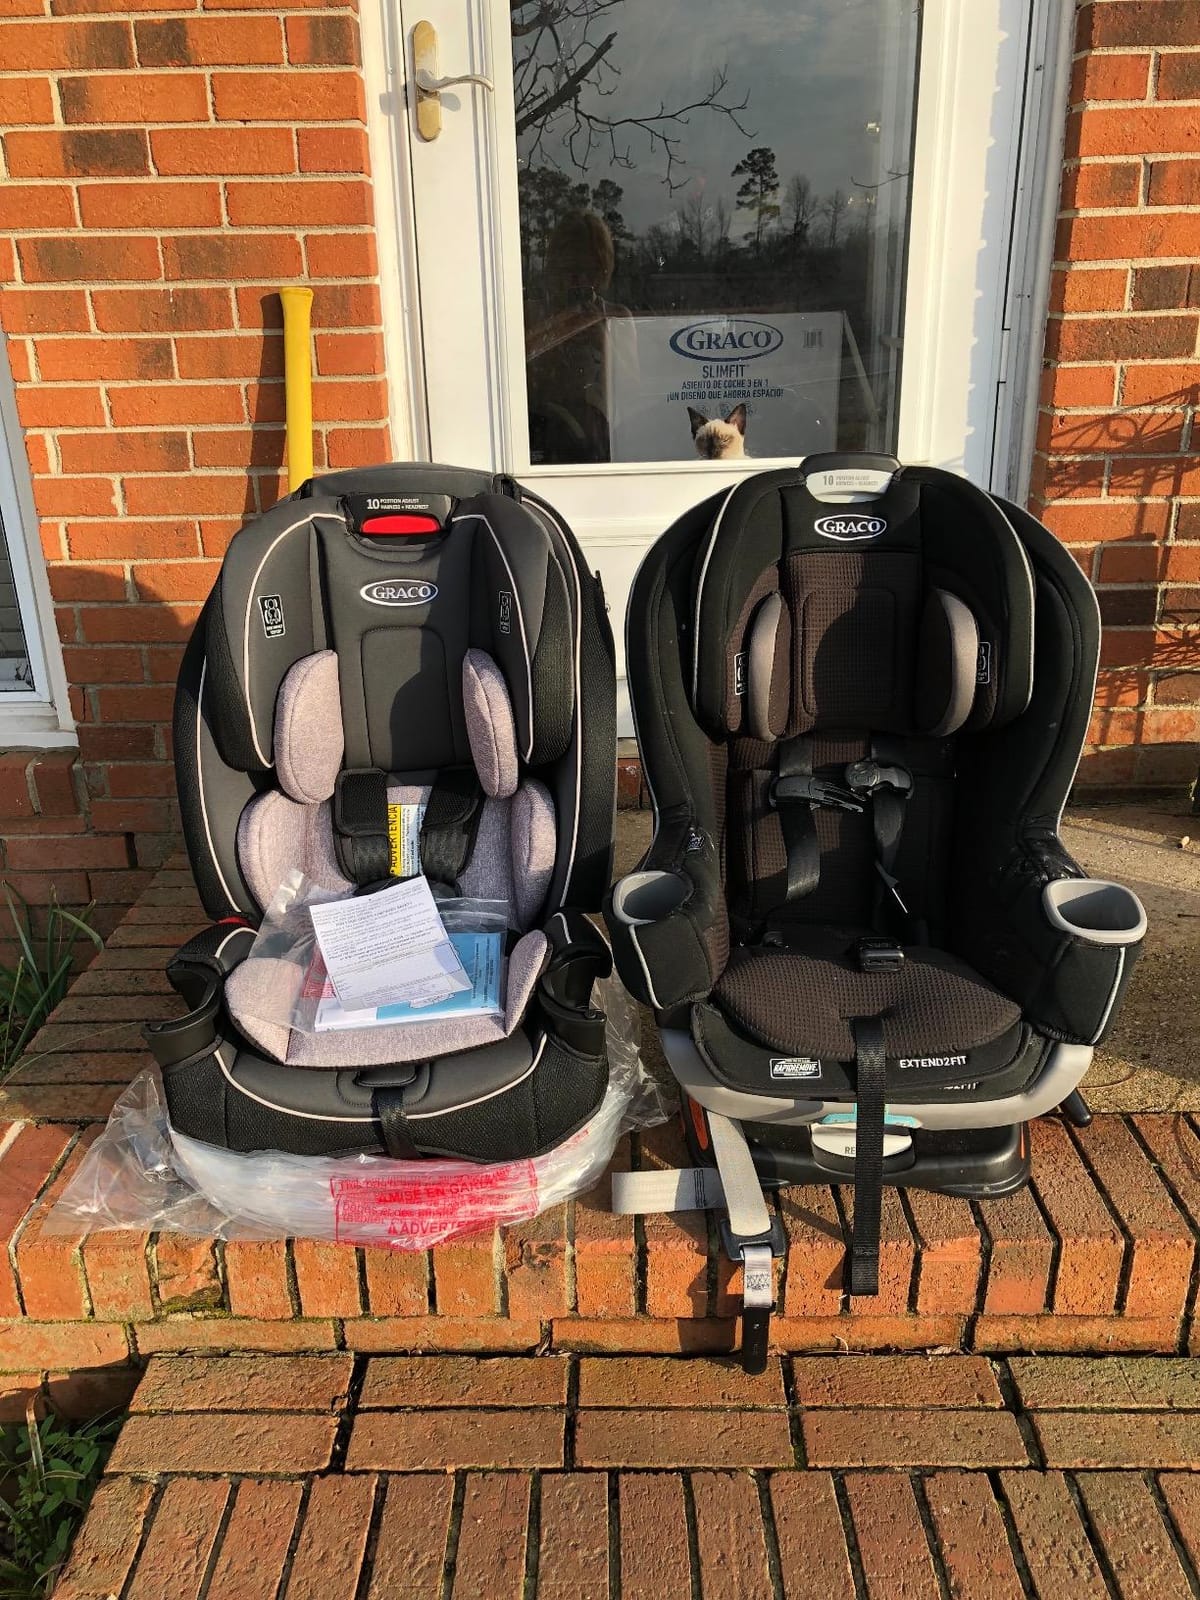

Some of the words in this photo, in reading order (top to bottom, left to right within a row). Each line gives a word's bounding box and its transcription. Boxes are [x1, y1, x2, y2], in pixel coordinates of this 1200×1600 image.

[686, 330, 772, 350] GRACO
[702, 365, 746, 378] SLIMFIT
[682, 380, 711, 390] ASIENTO
[713, 380, 722, 389] DE
[723, 379, 745, 389] COCHE
[754, 379, 763, 388] EN
[708, 390, 721, 399] QUE
[723, 389, 751, 399] AHORRA
[824, 475, 834, 486] 10
[366, 498, 380, 510] 10
[822, 520, 881, 533] GRACO
[372, 585, 432, 600] GRACO
[900, 1055, 968, 1070] EXTEND2FIT
